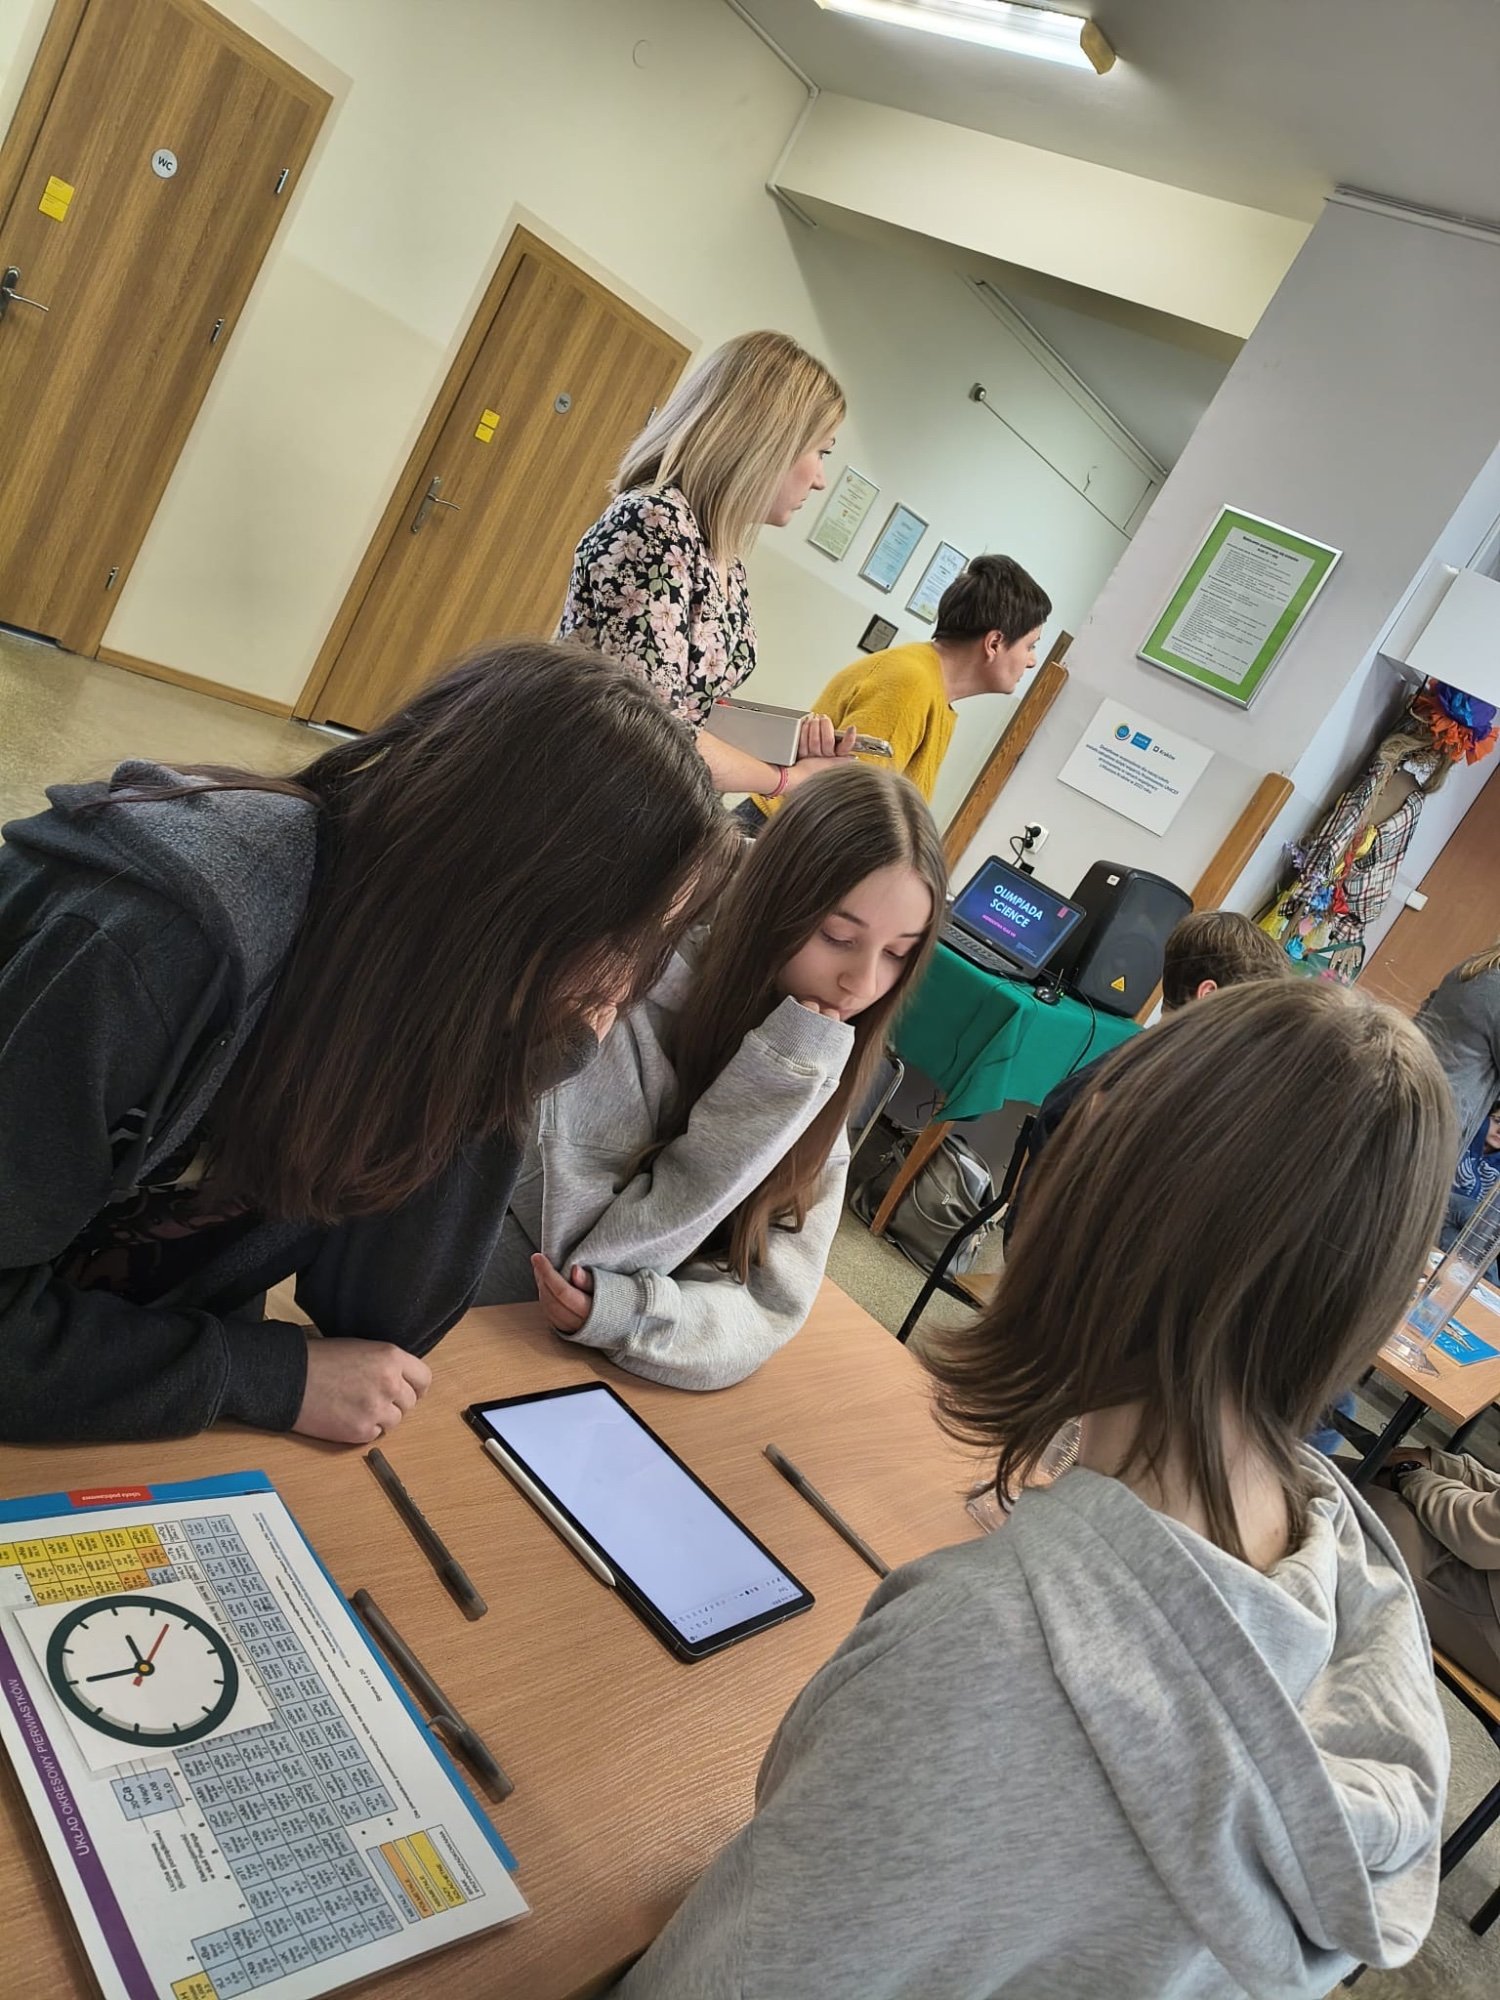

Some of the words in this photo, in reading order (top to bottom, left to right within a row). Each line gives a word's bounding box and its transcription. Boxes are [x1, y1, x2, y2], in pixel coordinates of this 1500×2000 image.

[158, 156, 173, 171] WC
[989, 898, 1031, 929] SCIENCE
[994, 884, 1044, 922] OLIMPIADA
[8, 1679, 48, 1753] PIERWIASTKÓW
[40, 1755, 73, 1814] OKRESOWY
[135, 1783, 152, 1805] Wapń
[66, 1816, 90, 1857] UKŁAD
